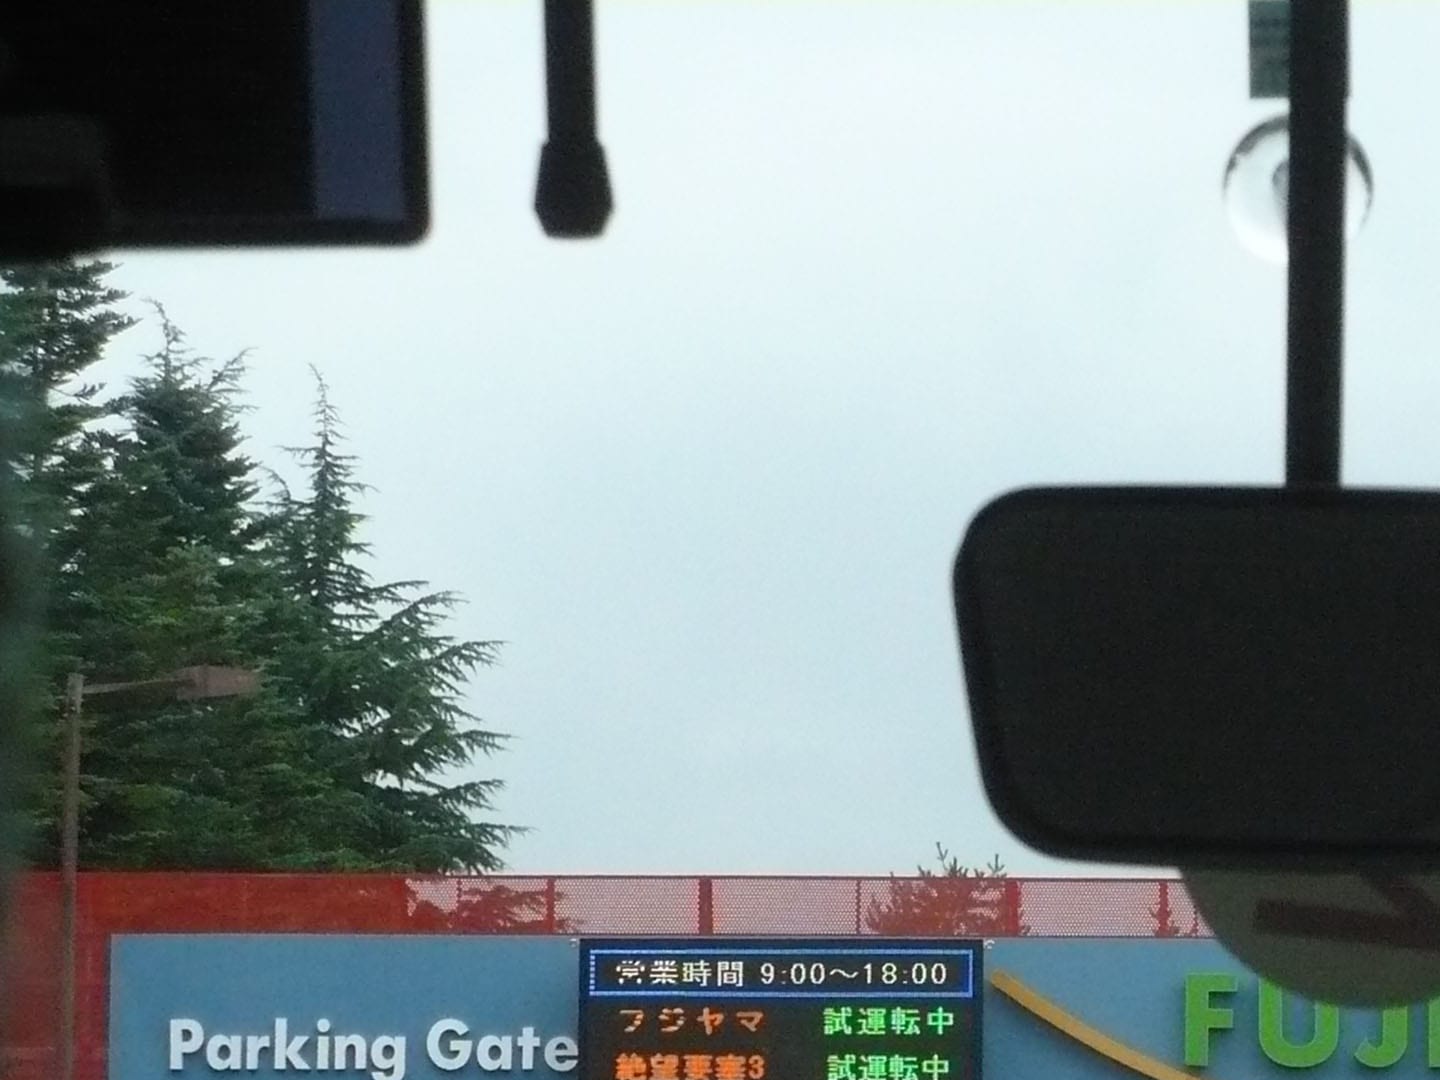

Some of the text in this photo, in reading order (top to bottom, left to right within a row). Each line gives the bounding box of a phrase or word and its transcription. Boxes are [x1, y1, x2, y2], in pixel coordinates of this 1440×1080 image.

[615, 960, 744, 987] 営業時間
[618, 1005, 955, 1036] フジヤマ 試運転中
[426, 1016, 579, 1073] Gate
